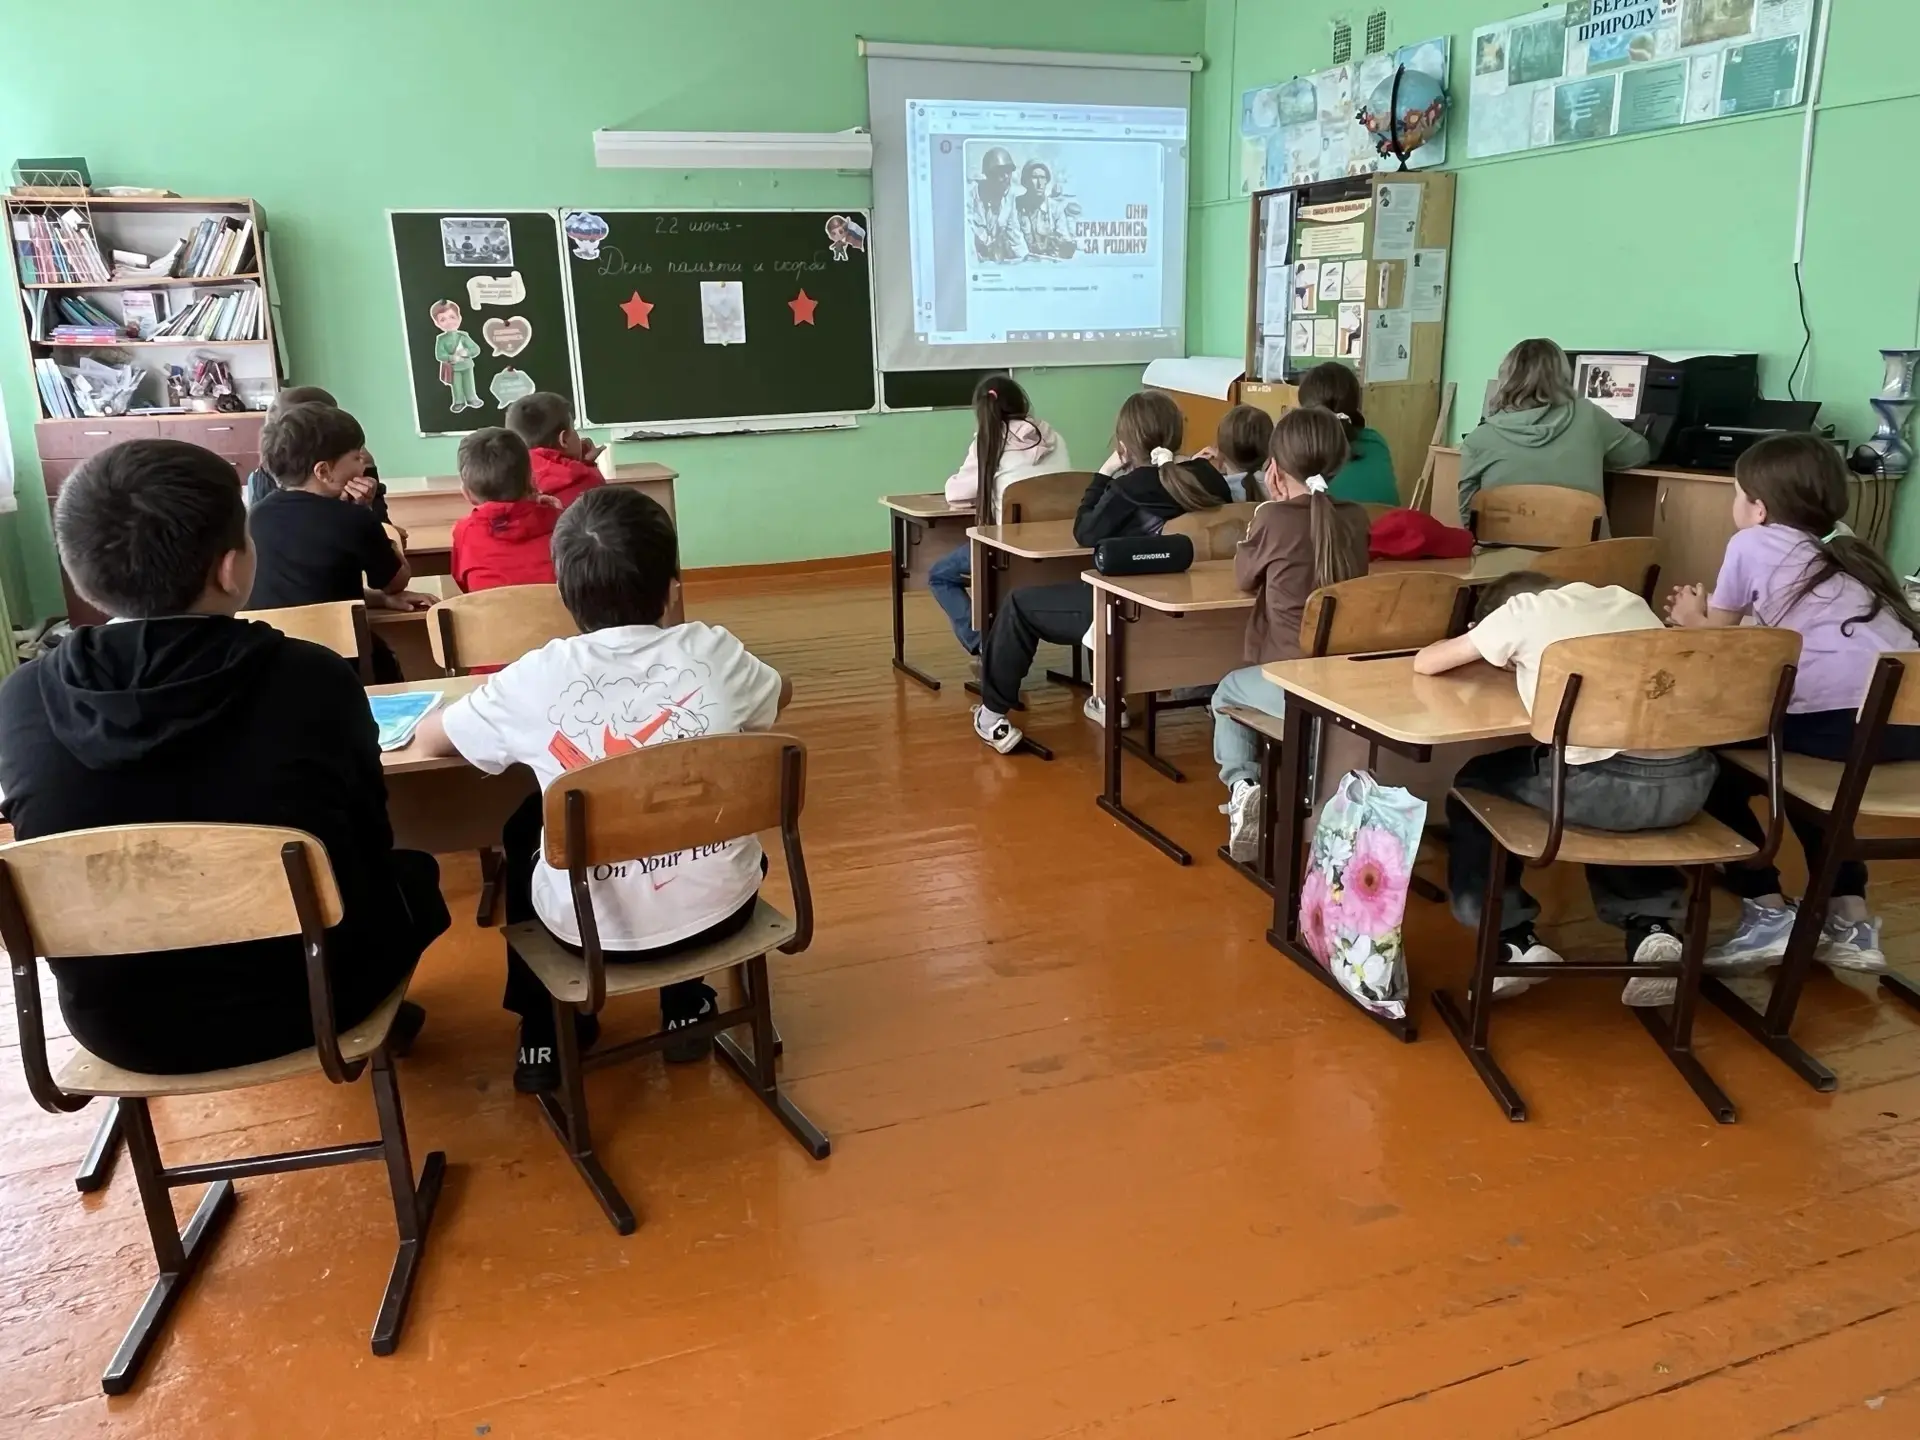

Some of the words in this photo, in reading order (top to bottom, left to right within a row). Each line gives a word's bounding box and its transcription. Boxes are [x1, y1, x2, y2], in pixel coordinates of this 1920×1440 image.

[1579, 6, 1658, 41] ПРИРОДУ
[1126, 204, 1147, 219] ОНИ
[655, 216, 679, 234] 22
[1076, 221, 1147, 236] СРАЖАЛИСЬ
[1084, 238, 1099, 253] ЗА
[1104, 238, 1147, 253] РОДИНУ
[598, 246, 653, 275] День
[668, 258, 743, 273] памяти
[753, 260, 765, 272] и
[1132, 552, 1170, 561] SOUNDMAX
[593, 864, 627, 881] On
[636, 852, 682, 875] Your
[519, 1047, 551, 1064] AIR
